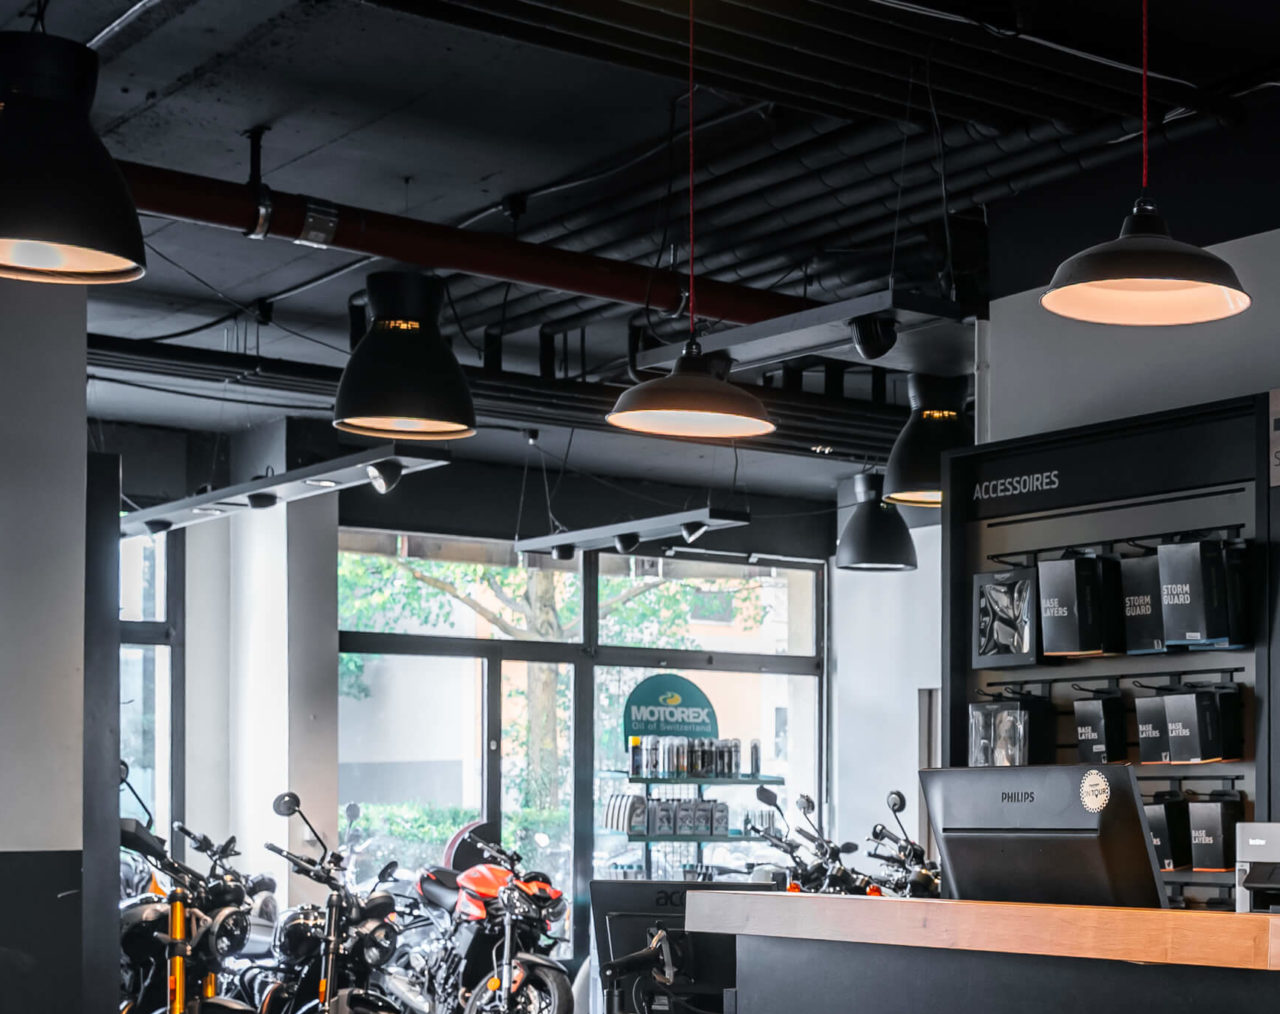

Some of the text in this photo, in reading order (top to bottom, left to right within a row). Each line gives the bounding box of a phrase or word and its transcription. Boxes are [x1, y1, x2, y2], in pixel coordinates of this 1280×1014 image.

[973, 471, 1059, 501] ACCESSOIRES
[1162, 584, 1190, 595] STORM
[1125, 595, 1151, 607] STORM
[1162, 594, 1191, 605] GUARD
[1125, 605, 1152, 616] GUARD
[631, 705, 711, 723] MOTOREX
[1077, 726, 1092, 734] BASE
[1139, 724, 1153, 732] BASE
[1168, 722, 1183, 731] BASE
[1078, 732, 1099, 740] LAYERS
[1139, 730, 1160, 738] LAYERS
[1168, 729, 1190, 737] LAYERS
[1001, 791, 1035, 803] PHILIPS
[1192, 836, 1213, 844] LAYERS
